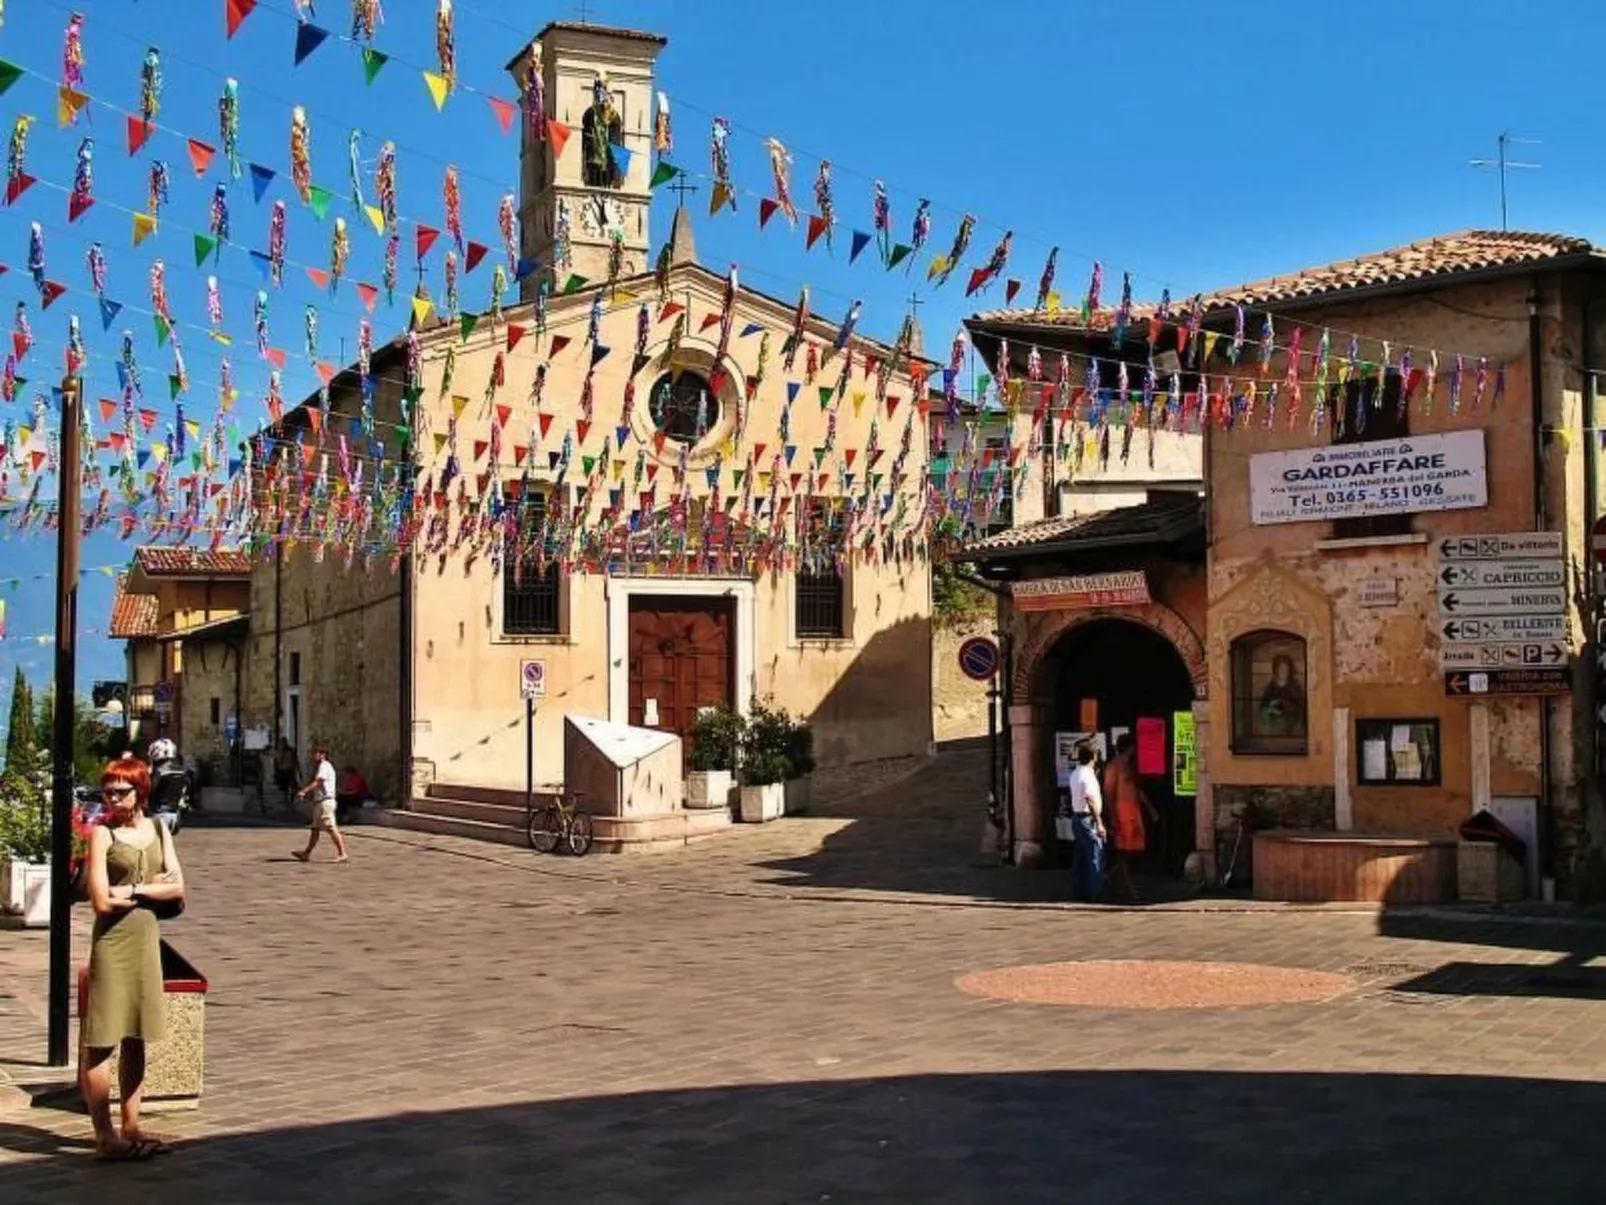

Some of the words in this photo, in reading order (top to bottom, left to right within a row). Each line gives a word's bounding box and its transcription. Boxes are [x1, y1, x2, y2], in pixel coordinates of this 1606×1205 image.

[1283, 453, 1446, 482] GARDAFFARE
[1426, 467, 1470, 480] GARDA
[1288, 493, 1322, 508] Tel.
[1483, 571, 1561, 584] CAPRICCIO
